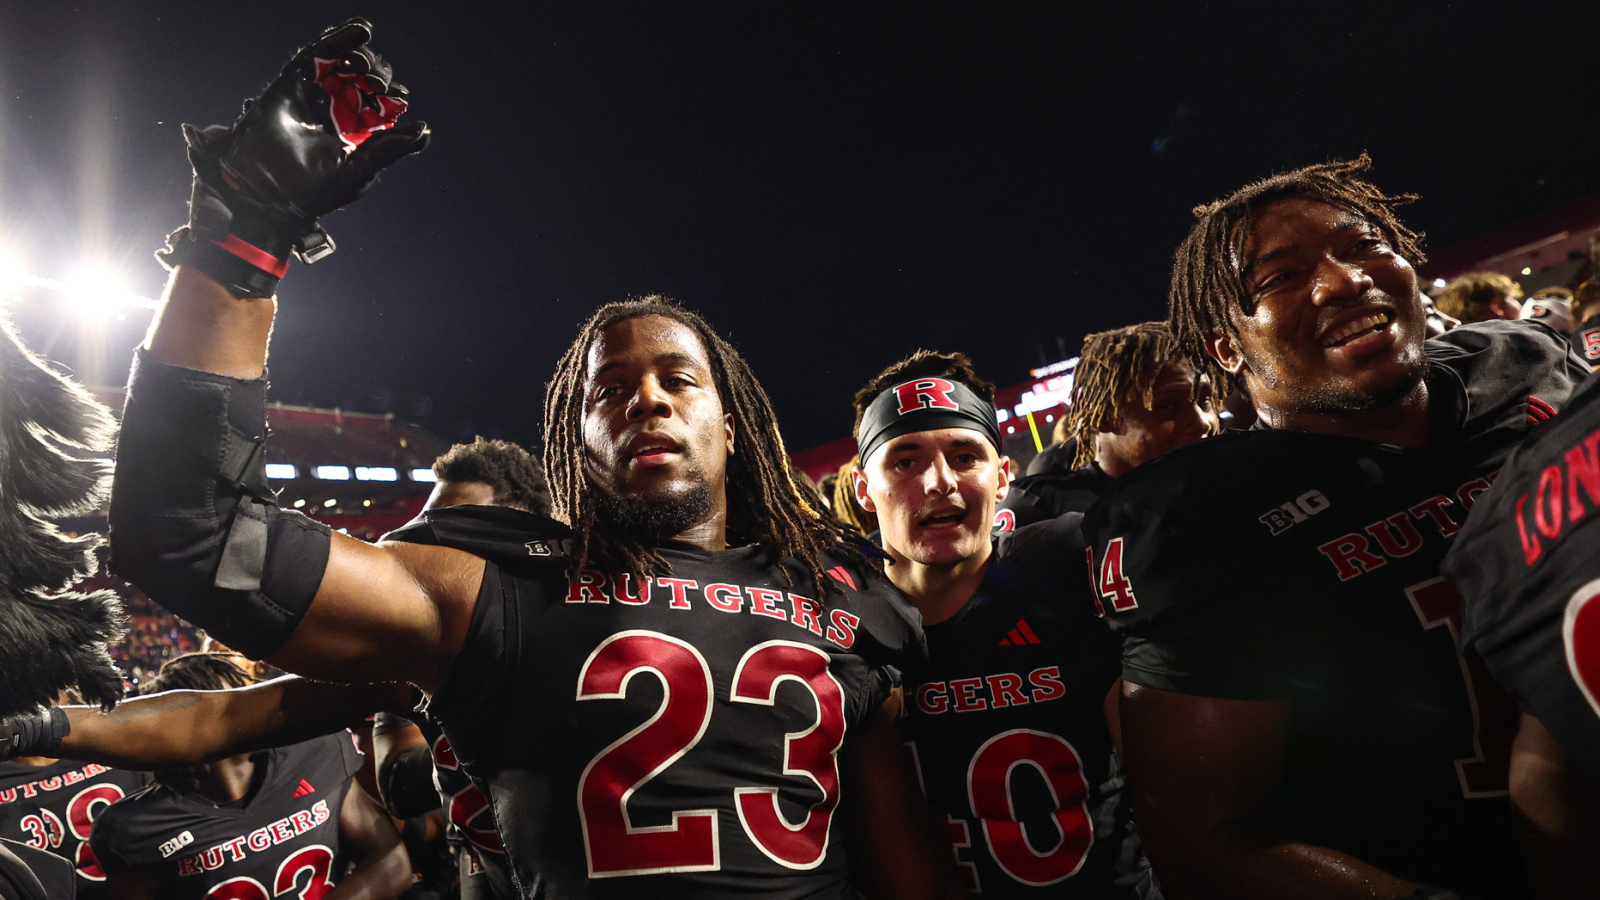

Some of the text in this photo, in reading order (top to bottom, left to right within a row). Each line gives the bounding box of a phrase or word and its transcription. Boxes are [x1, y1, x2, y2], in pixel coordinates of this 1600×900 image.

[892, 377, 959, 416] R
[565, 569, 861, 650] RUTGERS
[904, 665, 1066, 715] GERS
[576, 629, 847, 878] 23
[177, 799, 331, 877] RUTGERS
